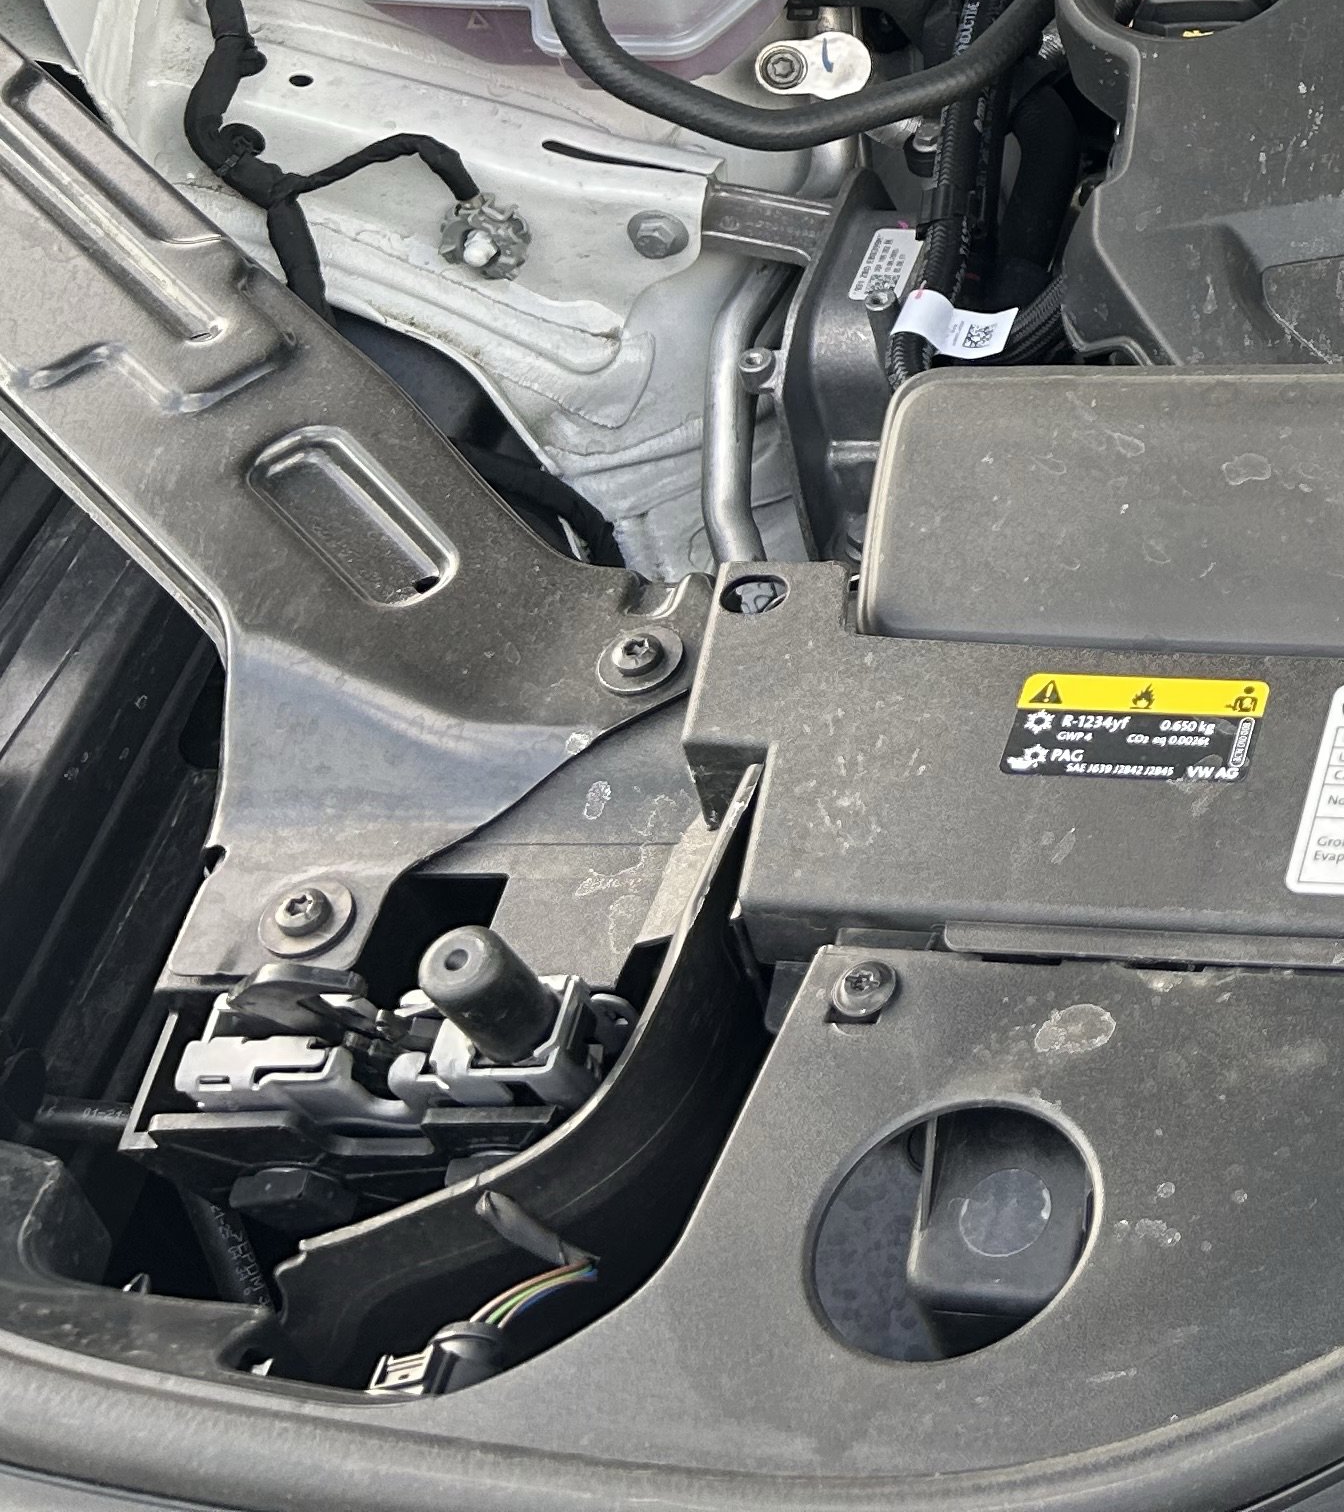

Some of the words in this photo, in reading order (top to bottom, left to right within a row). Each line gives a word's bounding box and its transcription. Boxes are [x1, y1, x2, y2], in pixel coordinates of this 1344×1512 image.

[1061, 715, 1132, 733] R-1234yf
[1159, 719, 1198, 732] 0.650
[1197, 720, 1217, 736] kg
[1056, 731, 1083, 741] GWP
[1050, 748, 1084, 762] PAG
[1066, 762, 1087, 773] SAE
[1187, 766, 1216, 778] VW
[1214, 767, 1239, 779] AG
